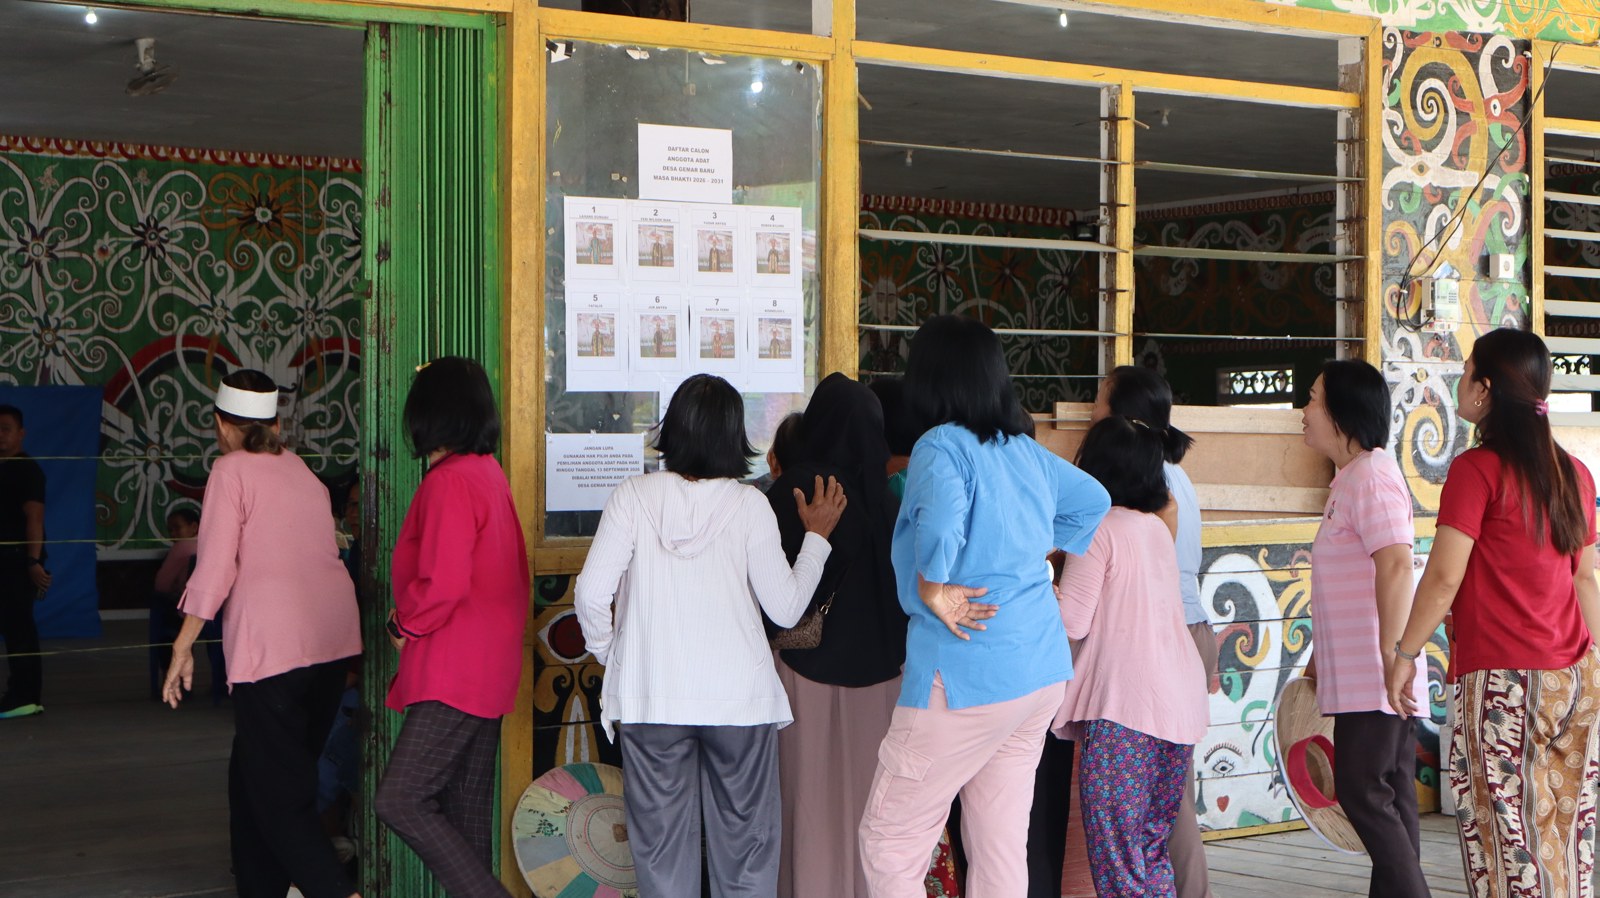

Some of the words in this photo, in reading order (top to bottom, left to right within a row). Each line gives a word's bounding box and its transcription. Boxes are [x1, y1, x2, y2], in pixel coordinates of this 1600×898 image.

[712, 212, 717, 220] 3
[770, 214, 775, 222] 4
[593, 294, 598, 302] 5
[655, 295, 660, 303] 6
[715, 298, 719, 306] 7
[772, 299, 777, 307] 8
